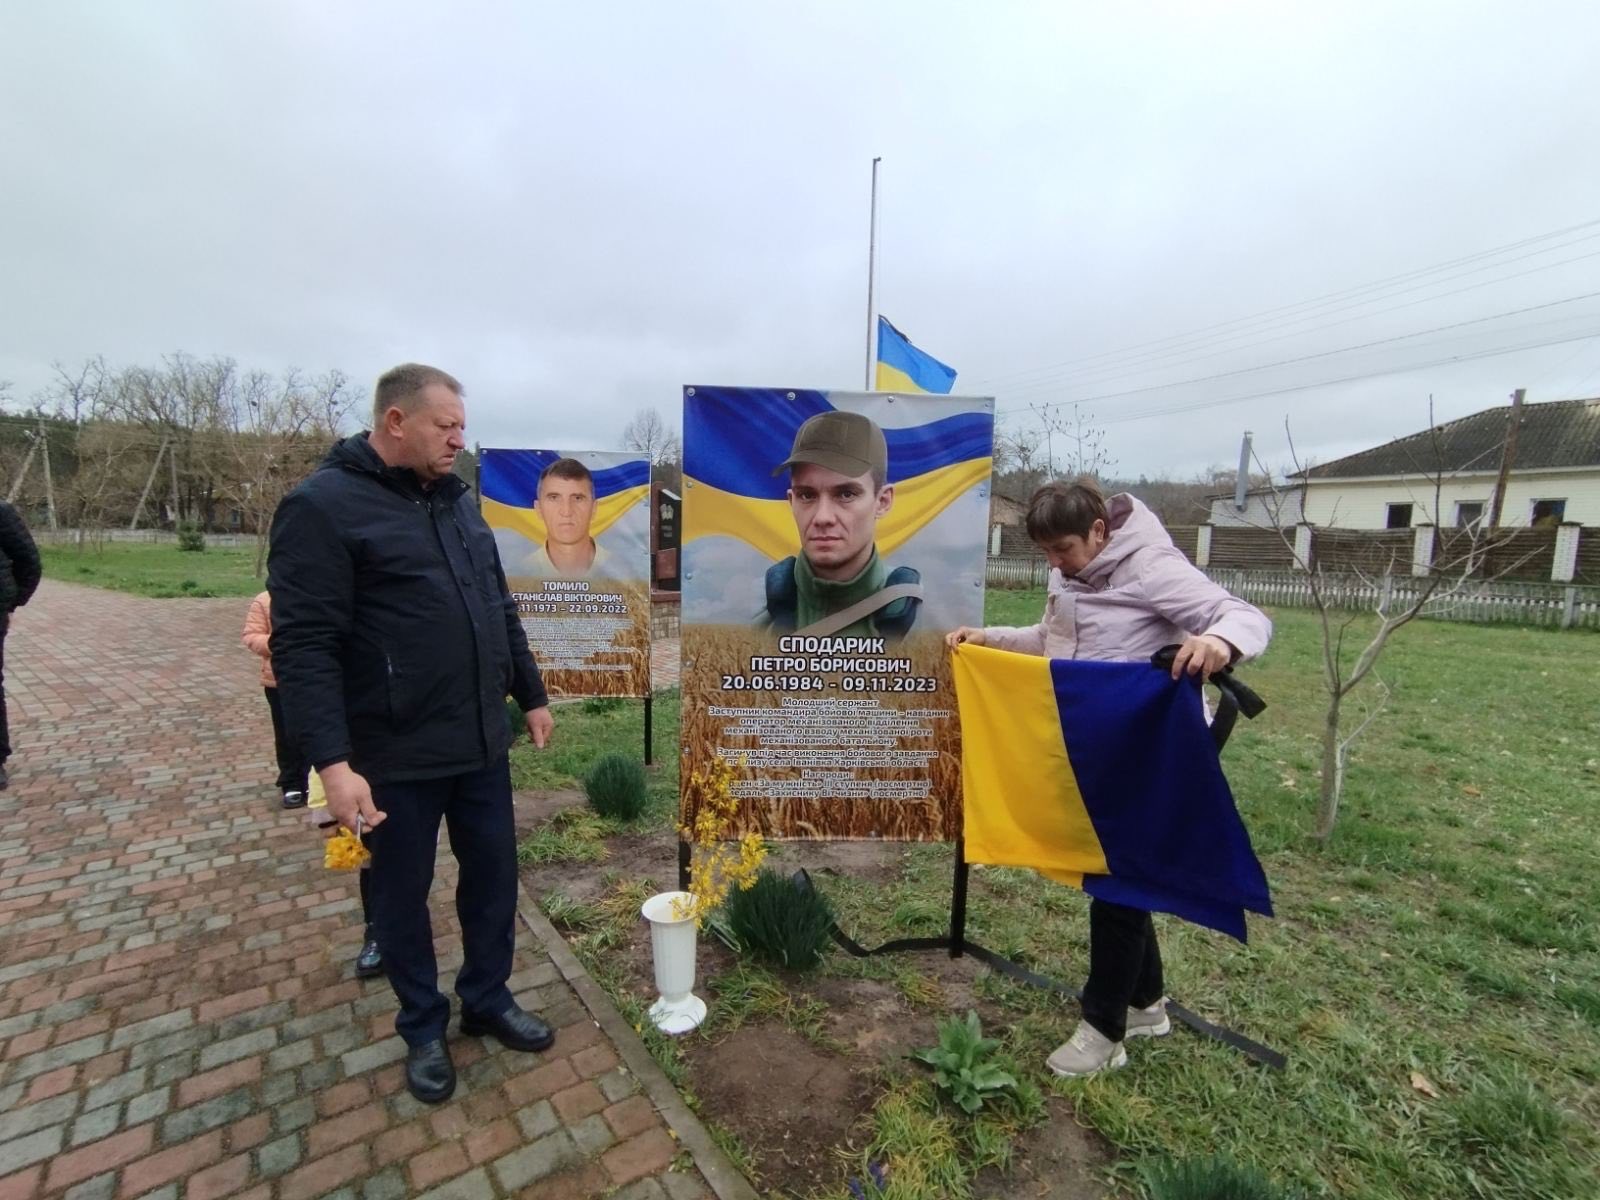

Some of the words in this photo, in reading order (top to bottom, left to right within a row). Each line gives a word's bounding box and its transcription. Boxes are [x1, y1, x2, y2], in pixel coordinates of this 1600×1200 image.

[543, 581, 590, 592] ТОМИЛО
[512, 592, 562, 602] СТАНІСЛАВ
[564, 593, 623, 603] ВІКТОРОВИЧ
[518, 603, 557, 613] .11.1973
[569, 604, 628, 614] 22.09.2022
[779, 635, 885, 654] СПОДАРИК
[751, 657, 806, 673] ПЕТРО
[810, 658, 911, 674] БОРИСОВИЧ
[722, 675, 824, 691] 20.06.1984
[842, 677, 937, 692] 09.11.2023
[782, 697, 835, 707] Молодший
[837, 699, 879, 708] сержант
[709, 706, 760, 717] Заступник
[762, 708, 817, 717] командира
[818, 708, 856, 717] бойової
[906, 709, 949, 718] навідник
[740, 718, 786, 727] оператор
[788, 718, 866, 727] механізованого
[867, 718, 919, 727] відділення
[724, 726, 803, 735] механізованого
[804, 728, 838, 737] взводу
[839, 727, 908, 736] механізованої
[910, 730, 933, 738] роти
[760, 736, 838, 745] механізованого
[839, 736, 898, 747] батальйону.
[717, 747, 757, 757] Загинув
[759, 748, 774, 758] під
[775, 749, 792, 757] час
[794, 749, 845, 758] виконання
[847, 748, 892, 758] бойового
[894, 750, 938, 759] завдання
[727, 758, 767, 769] полизу
[769, 759, 791, 767] села
[792, 758, 832, 767] Іванівка
[834, 758, 889, 769] Харківської
[803, 769, 849, 780] Нагороди
[834, 781, 872, 790] ступеня
[874, 779, 932, 790] (посмертно)
[870, 789, 928, 799] (посмертно)
